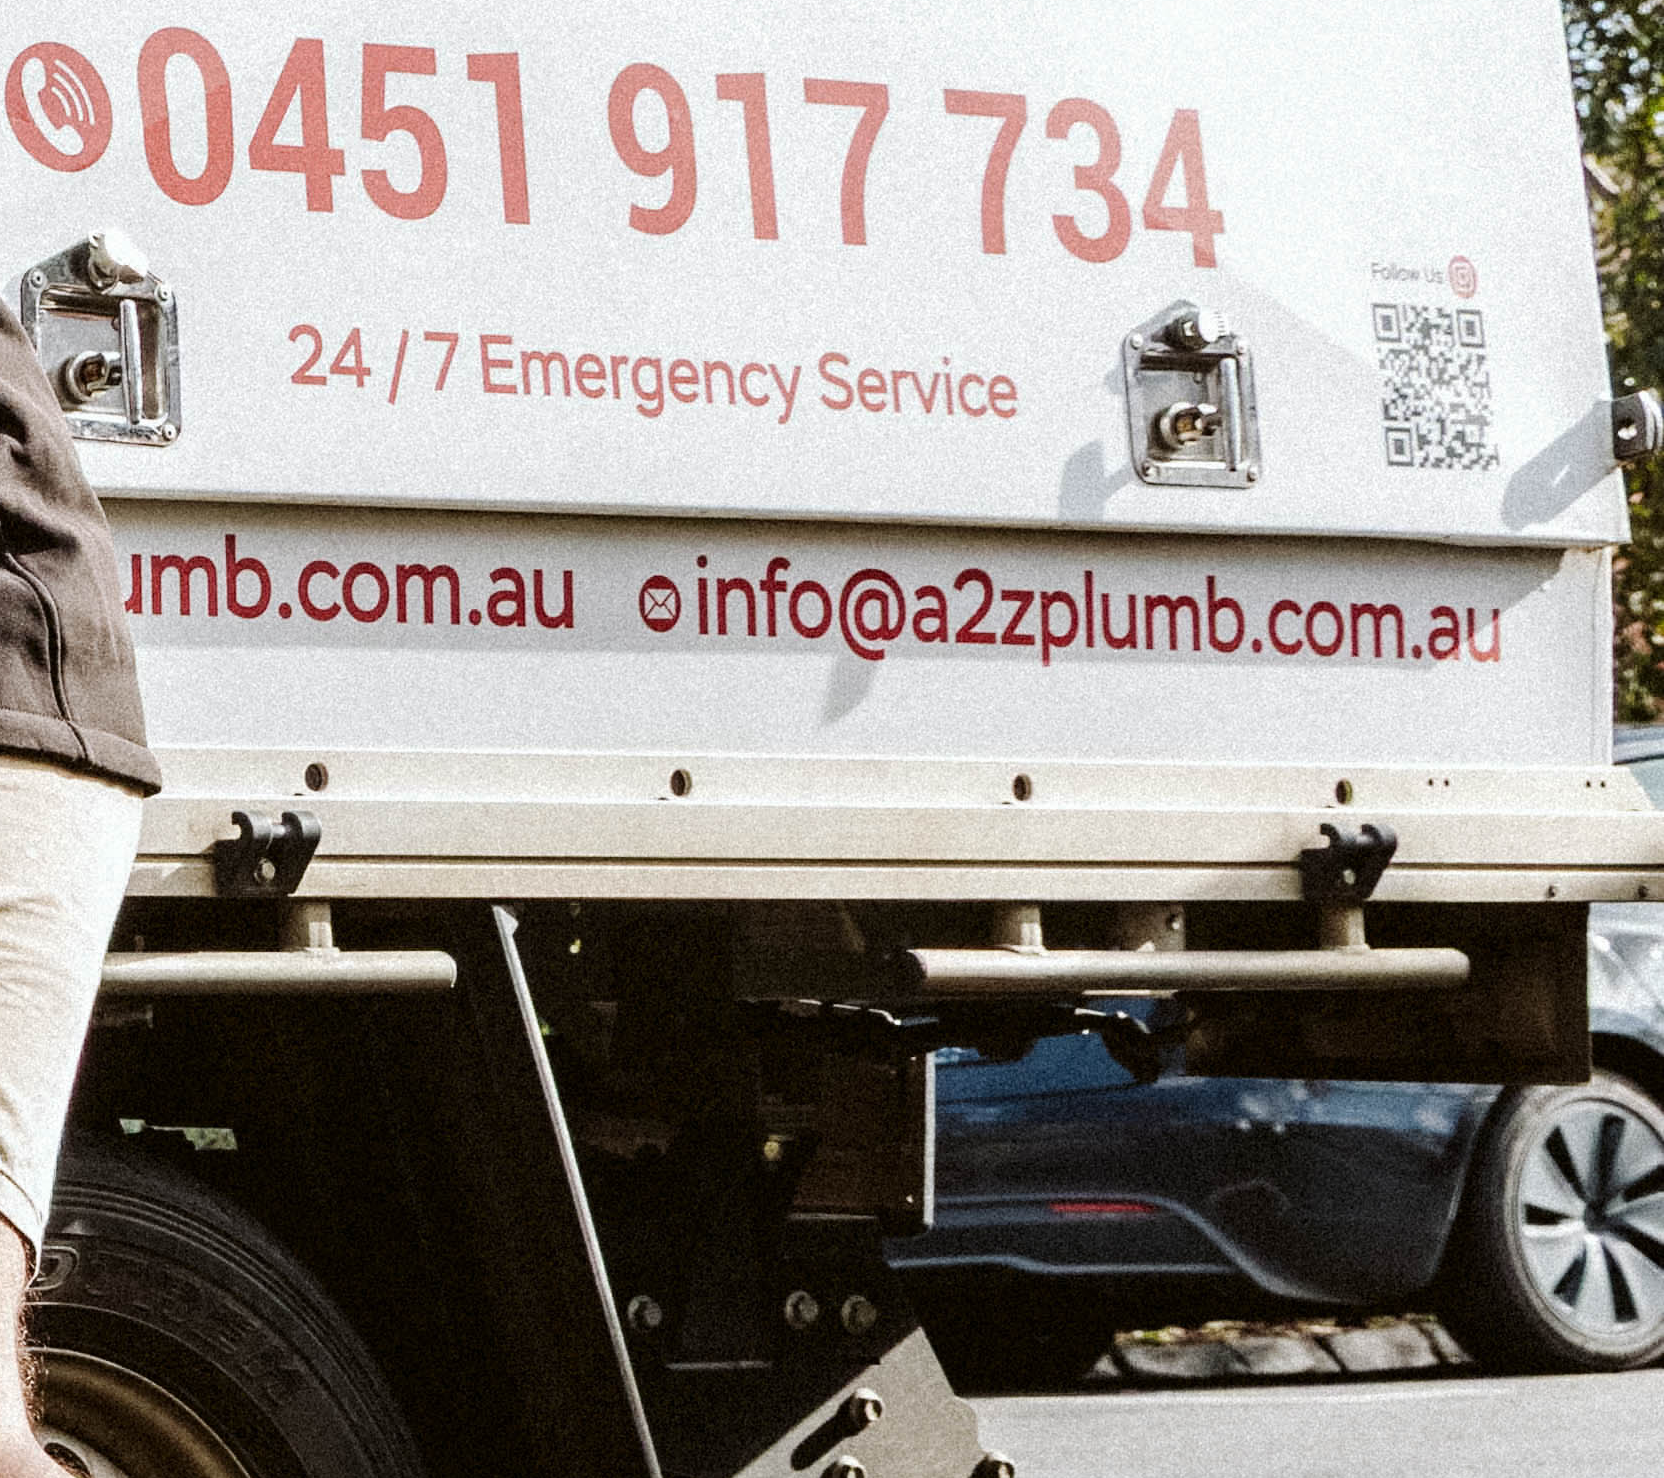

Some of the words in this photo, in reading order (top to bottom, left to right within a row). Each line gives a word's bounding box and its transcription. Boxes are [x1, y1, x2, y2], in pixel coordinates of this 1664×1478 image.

[137, 27, 530, 224] 0451
[609, 62, 889, 245] 917
[945, 89, 1225, 268] 734
[481, 335, 801, 424] Emergency
[819, 352, 1018, 418] Service
[696, 556, 1501, 665] info@a2zplumb.com.au
